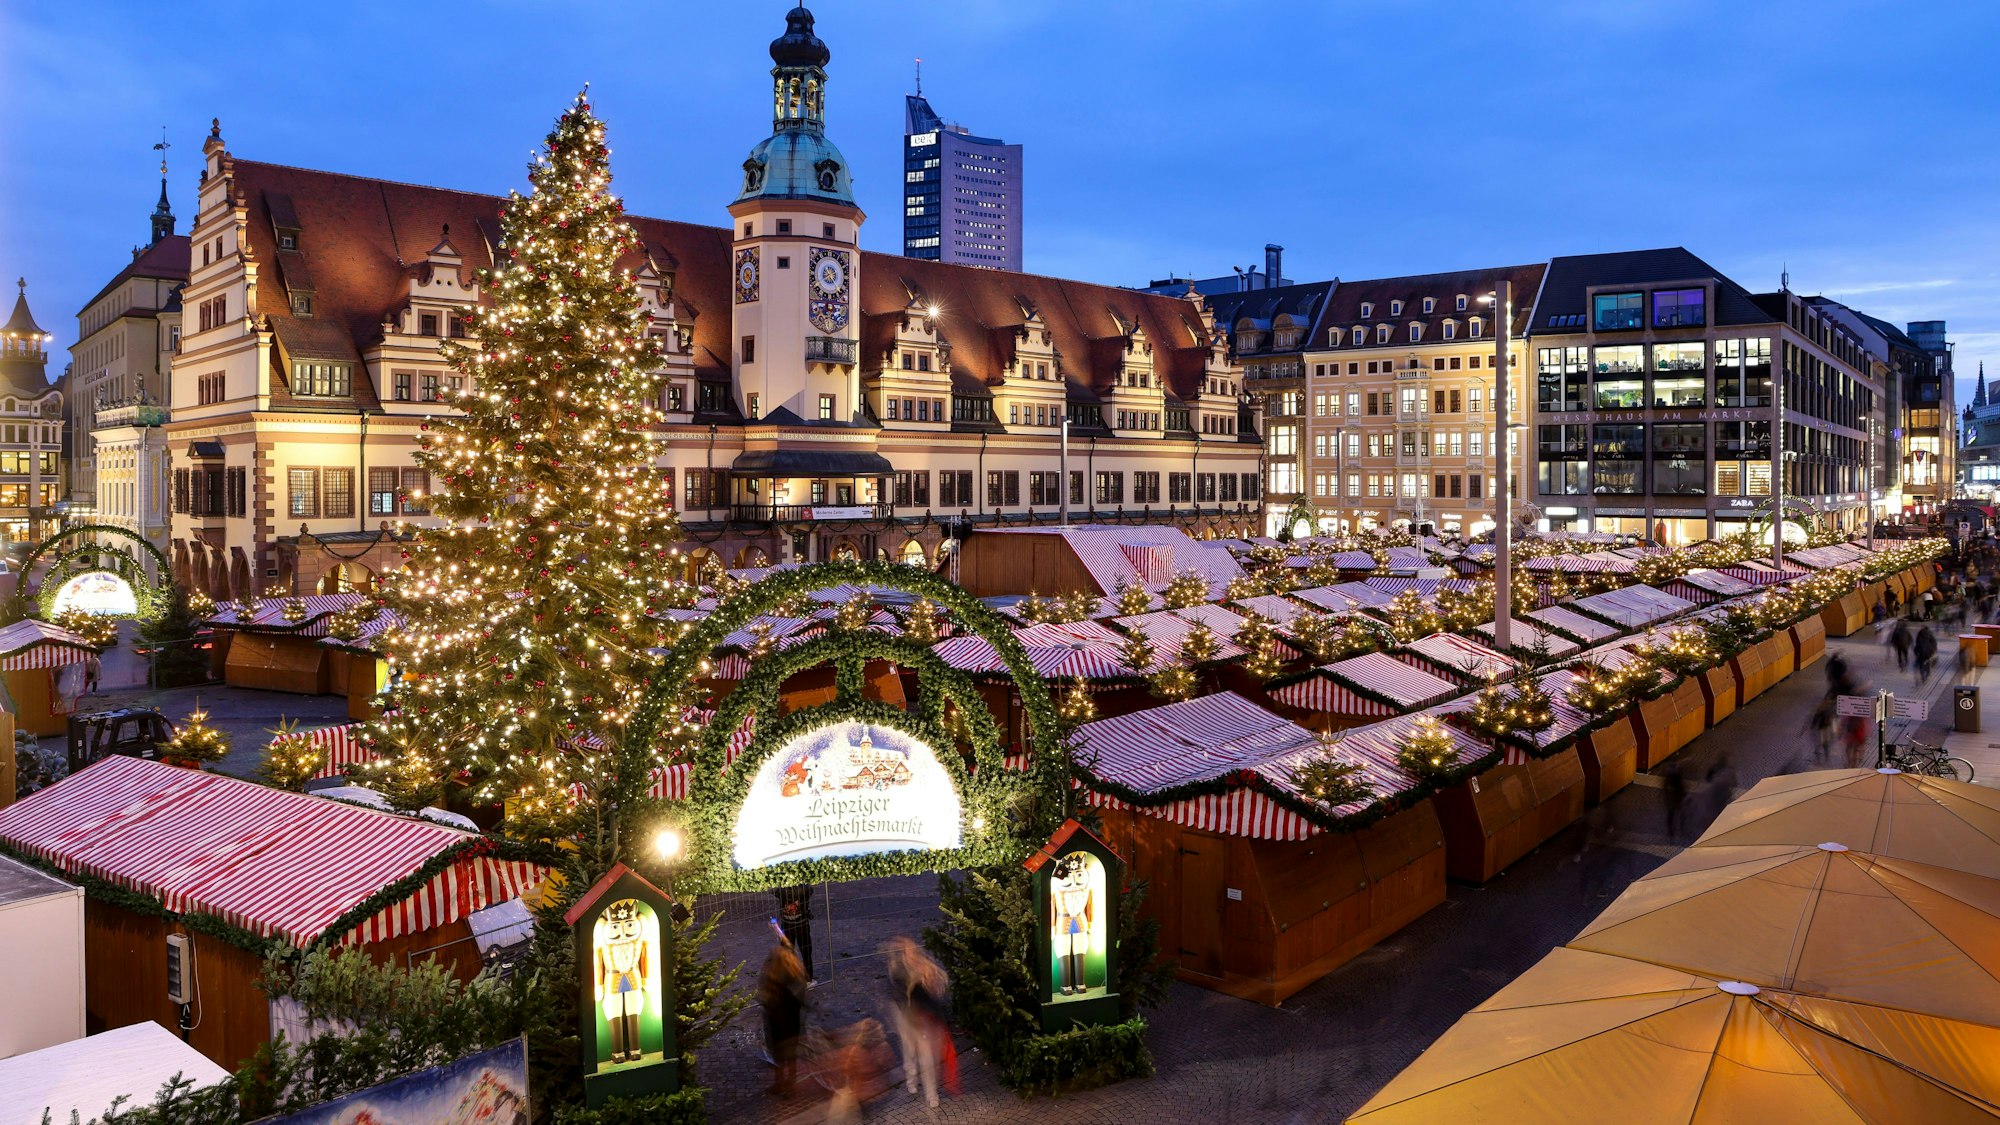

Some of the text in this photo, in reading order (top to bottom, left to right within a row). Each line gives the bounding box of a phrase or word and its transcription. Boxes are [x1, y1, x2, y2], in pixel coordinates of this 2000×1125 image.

[1553, 410, 1753, 422] MESSEHAUS AM MARKT
[1730, 499, 1754, 507] ZARA
[804, 794, 891, 820] Leipziger
[775, 814, 923, 846] Weihnachtsmarkt
